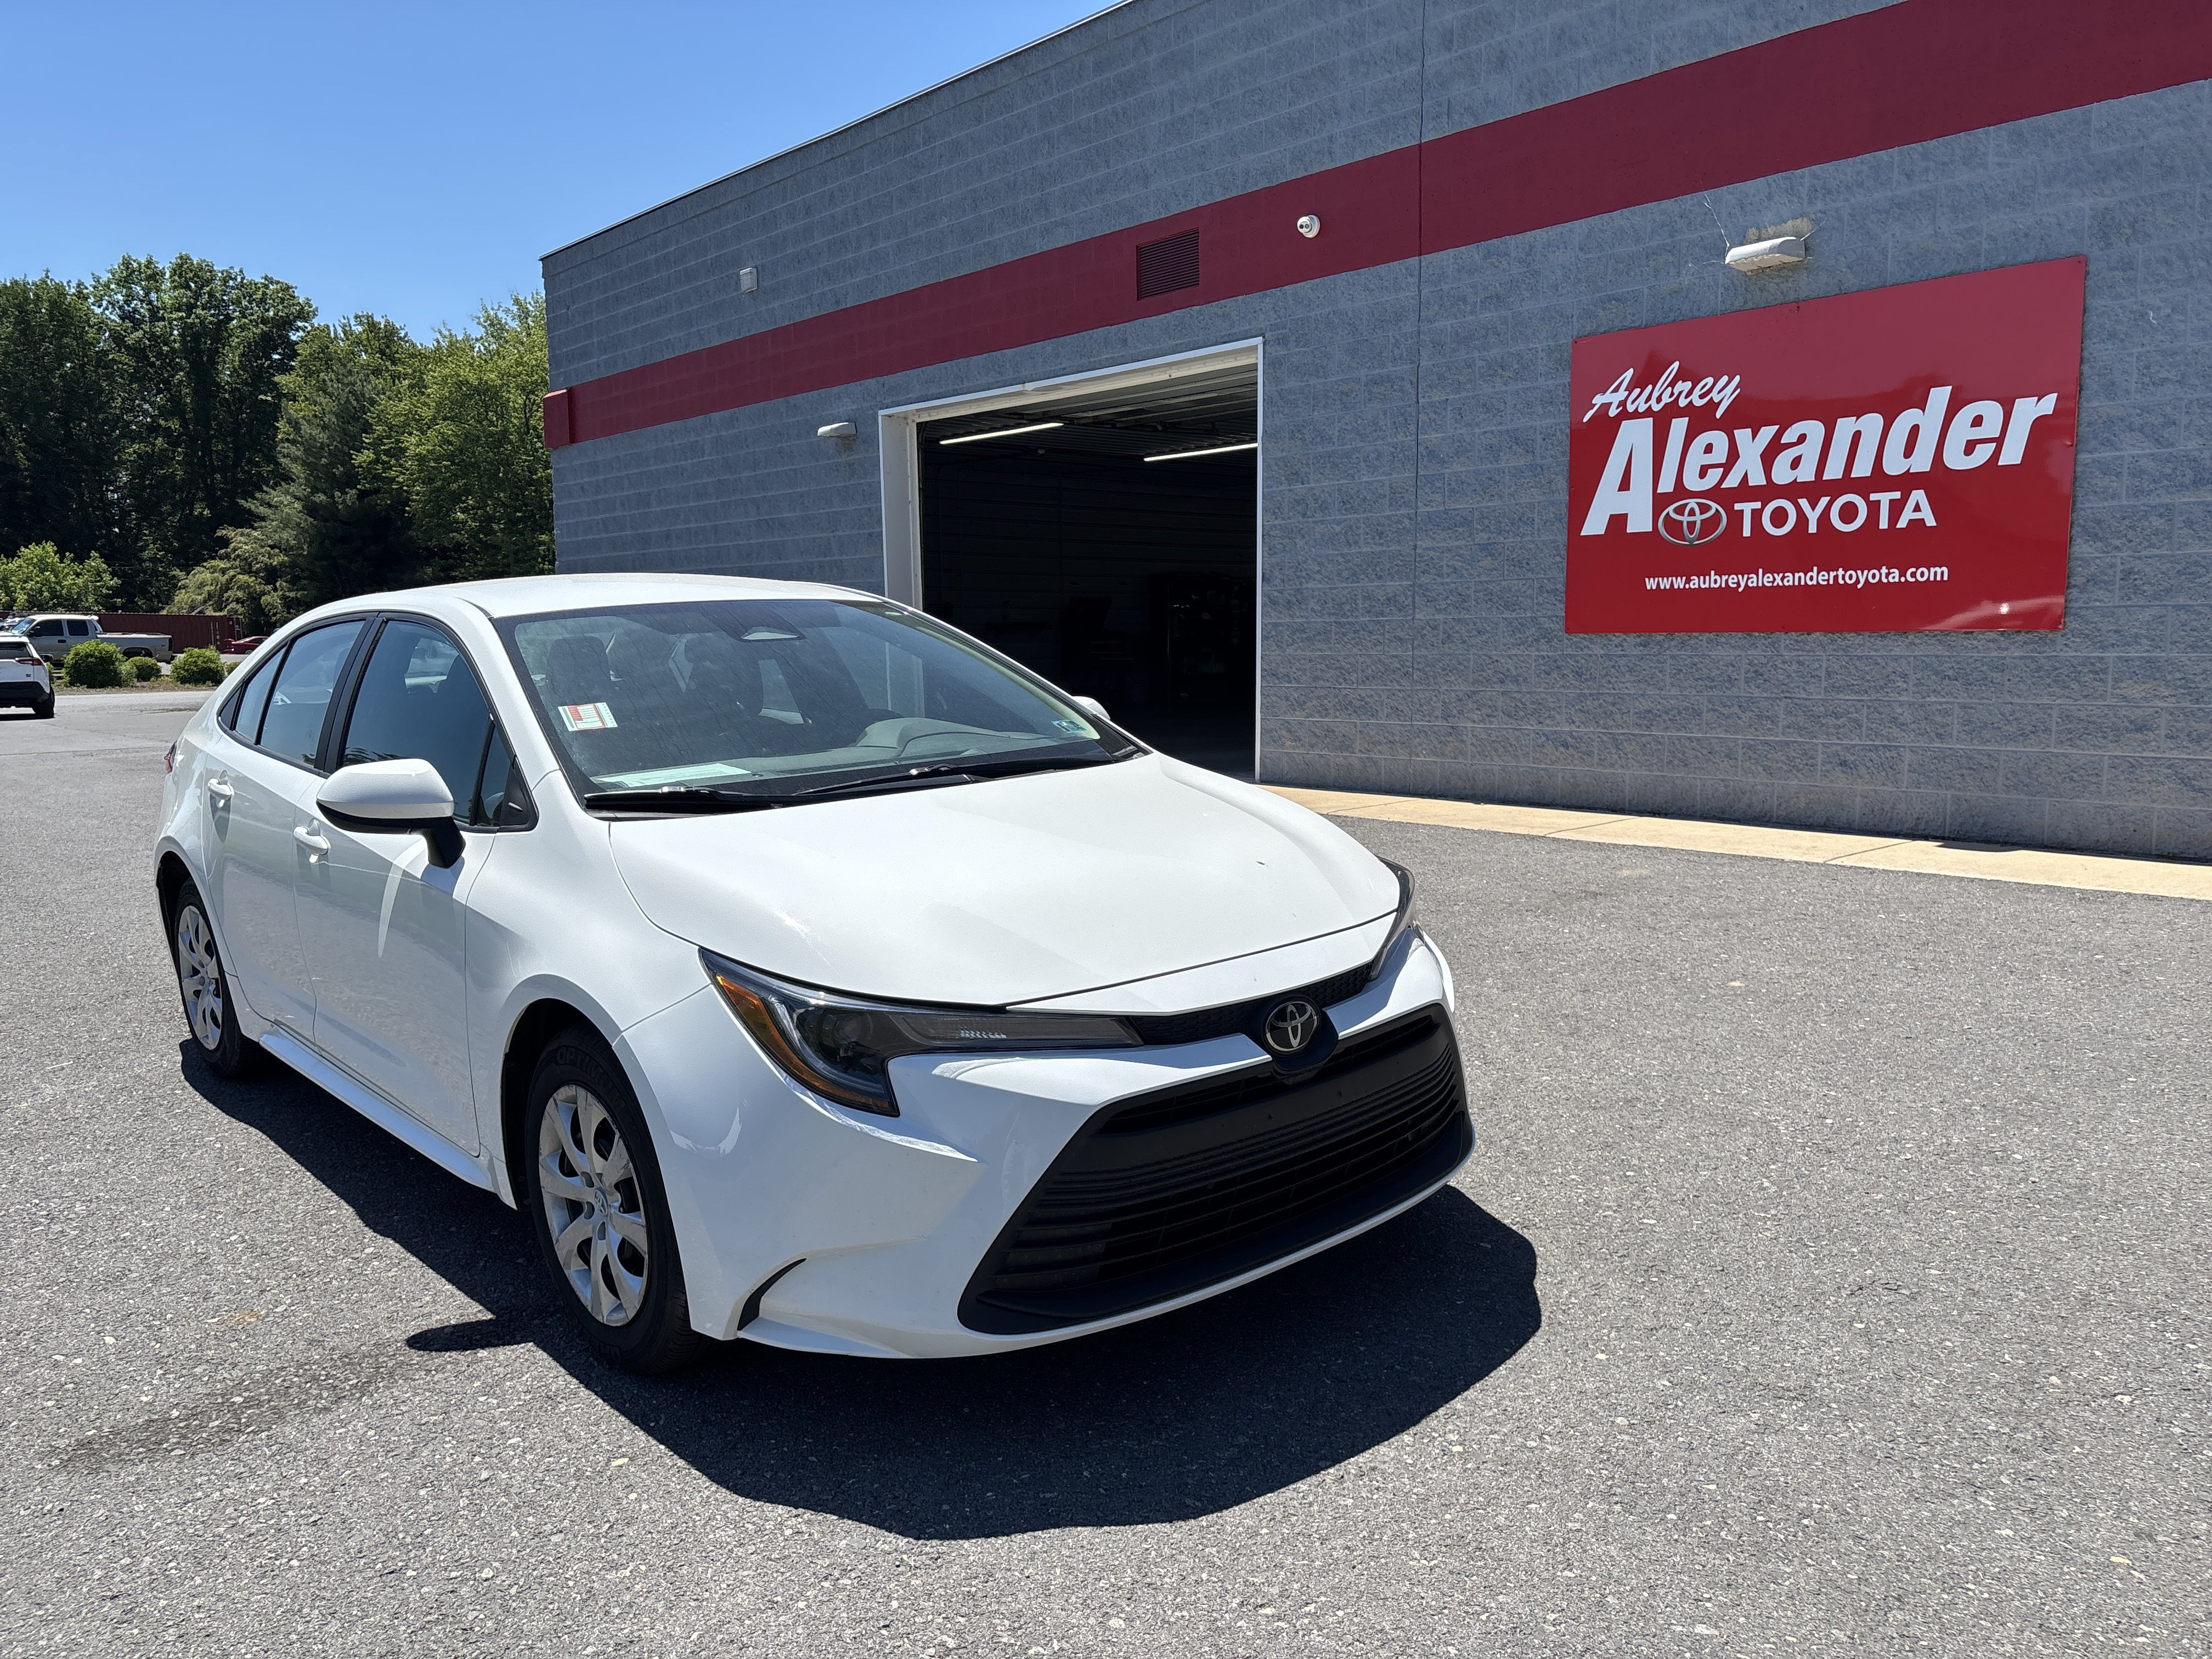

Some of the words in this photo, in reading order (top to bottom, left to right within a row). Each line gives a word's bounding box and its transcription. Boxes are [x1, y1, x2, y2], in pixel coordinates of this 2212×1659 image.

[1582, 360, 1741, 423] Aubrey
[1580, 385, 2058, 536] Alexander
[1734, 489, 1937, 537] TOYOTA
[1645, 566, 1949, 592] www.aubreyalexandertoyota.com
